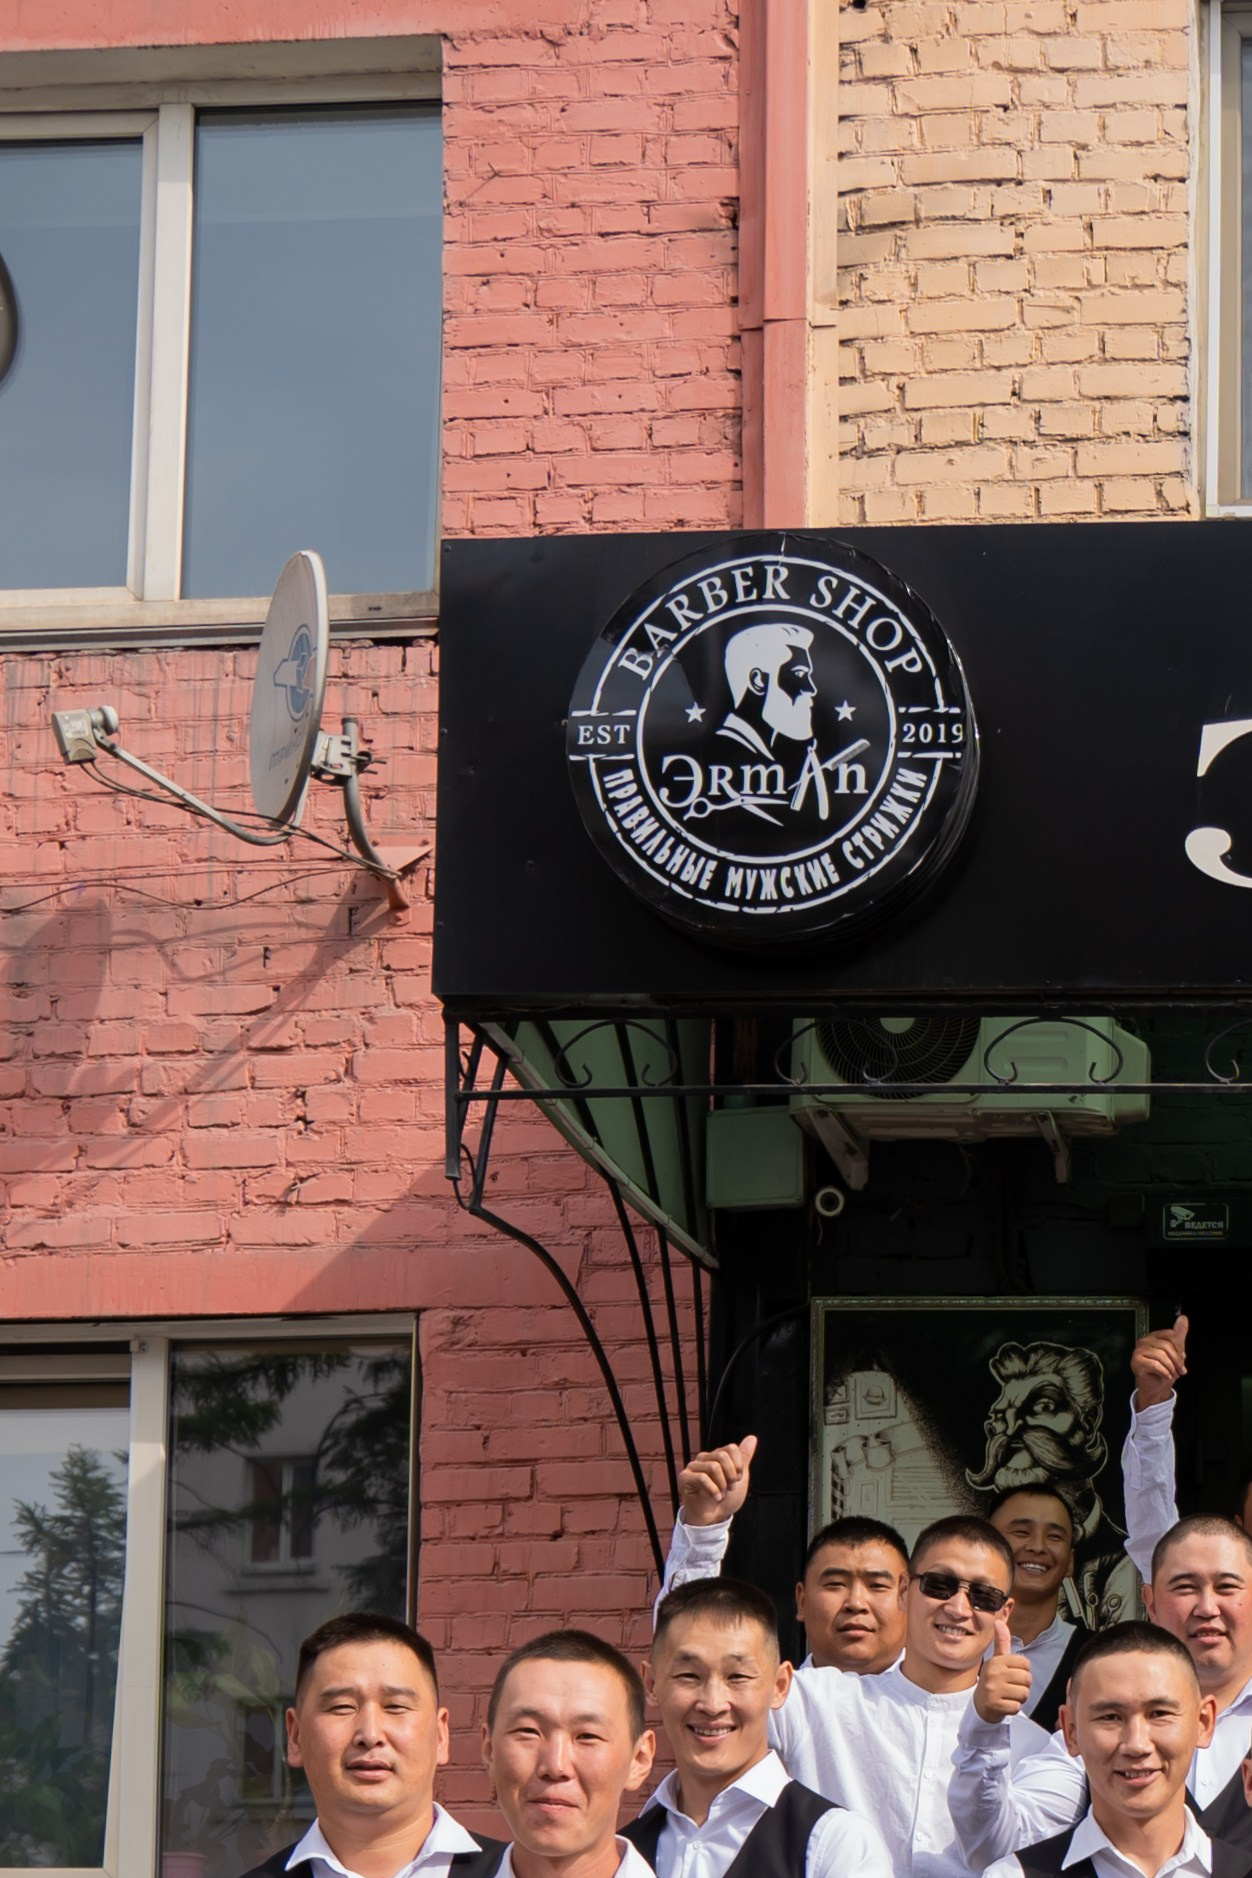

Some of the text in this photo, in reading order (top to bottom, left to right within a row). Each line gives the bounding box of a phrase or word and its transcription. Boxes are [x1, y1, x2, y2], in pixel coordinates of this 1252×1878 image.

[618, 565, 923, 681] BARBER SHOP
[577, 724, 631, 745] EST
[902, 723, 963, 744] 2019
[603, 767, 928, 901] ПРАВИЛЬНЫЕ МУЖСКИЕ СТРИЖКИ
